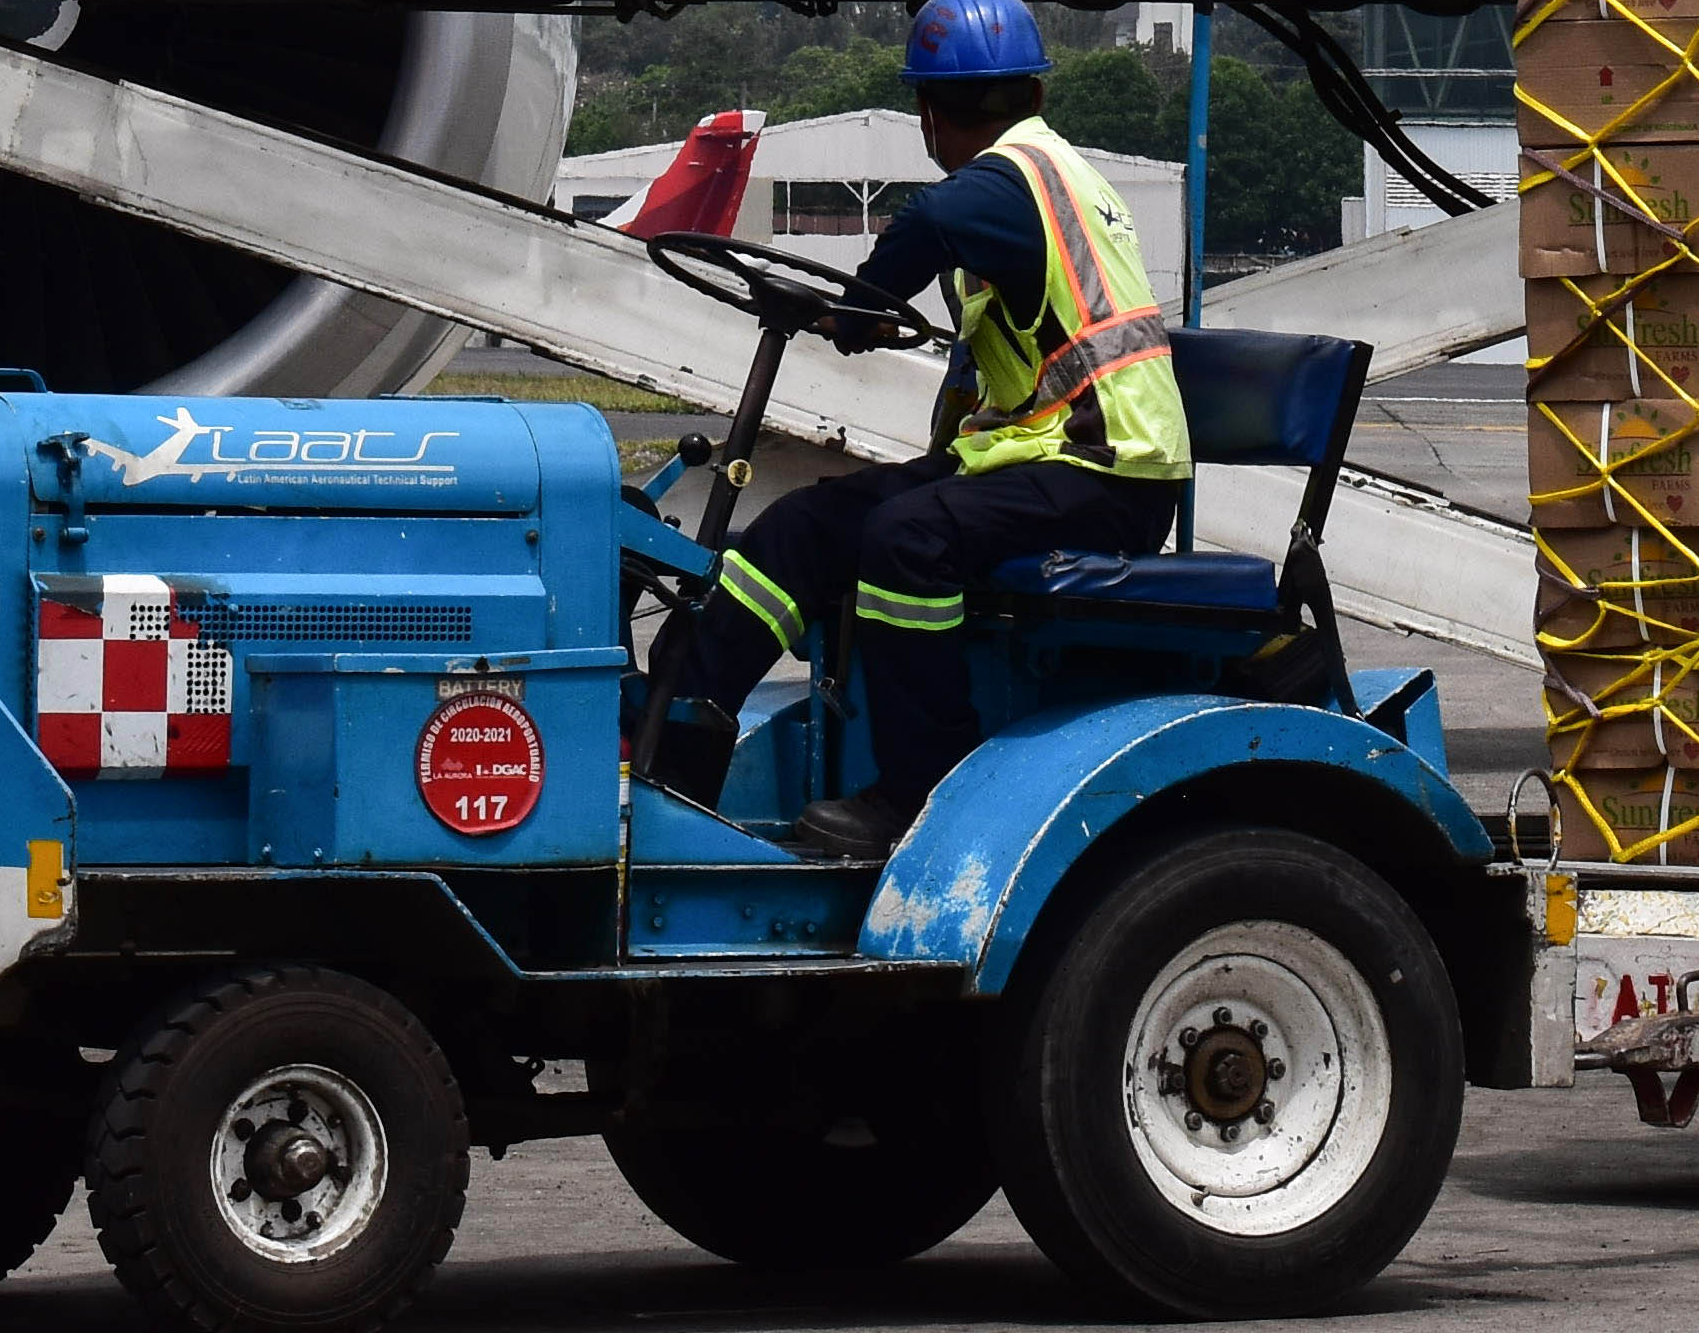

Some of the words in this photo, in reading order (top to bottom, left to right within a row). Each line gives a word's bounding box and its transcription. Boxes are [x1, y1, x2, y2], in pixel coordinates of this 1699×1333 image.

[238, 474, 261, 485] Latin
[263, 474, 308, 485] American
[312, 475, 370, 486] Aeronautical
[373, 475, 417, 486] Technical
[420, 476, 458, 488] Support
[450, 728, 511, 742] 2020-2021
[420, 734, 436, 783] PERMISO
[430, 720, 443, 734] DE
[502, 703, 541, 782] AEROPORTUARIO
[492, 764, 526, 775] DGAC
[455, 796, 508, 820] 117
